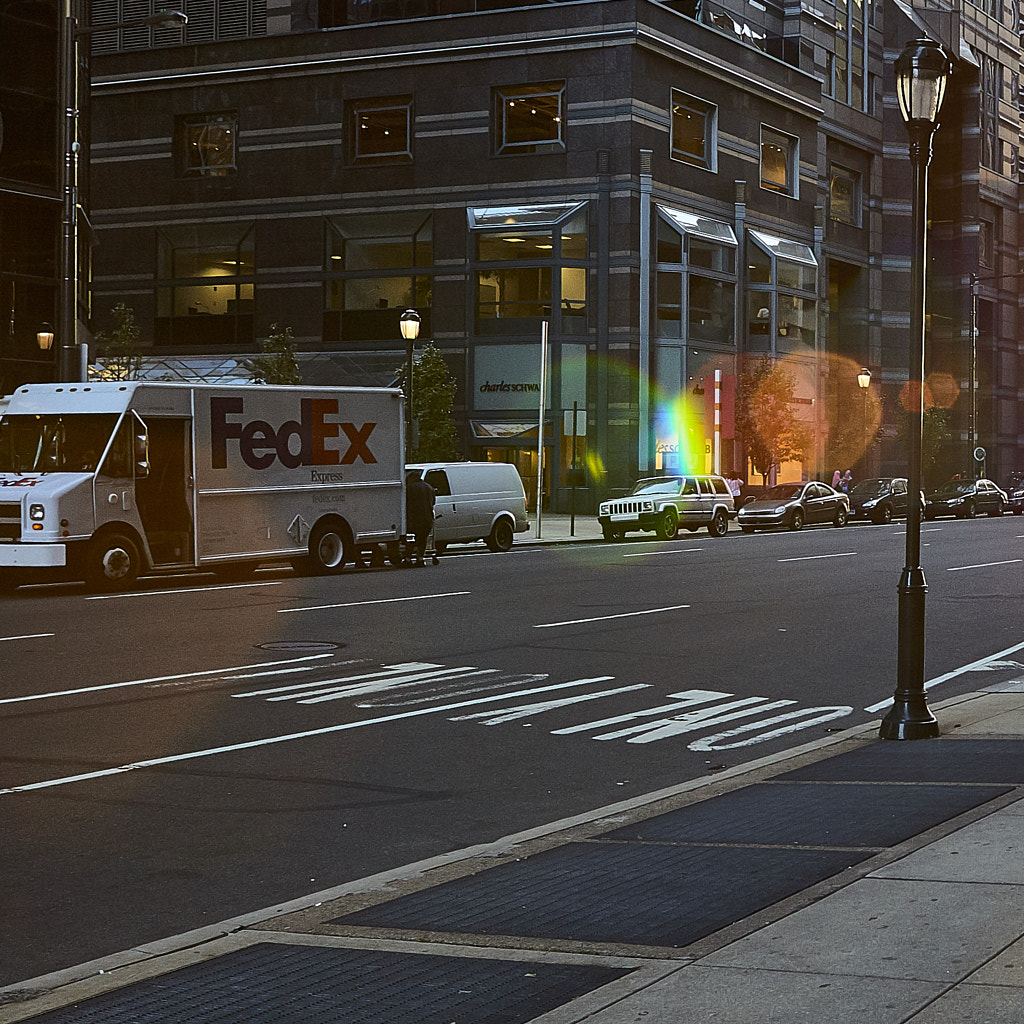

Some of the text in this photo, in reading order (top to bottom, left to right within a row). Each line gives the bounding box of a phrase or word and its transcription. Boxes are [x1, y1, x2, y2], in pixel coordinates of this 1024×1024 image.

[480, 381, 541, 392] charles SCHWA
[210, 397, 378, 470] FedEx
[311, 470, 343, 484] Express
